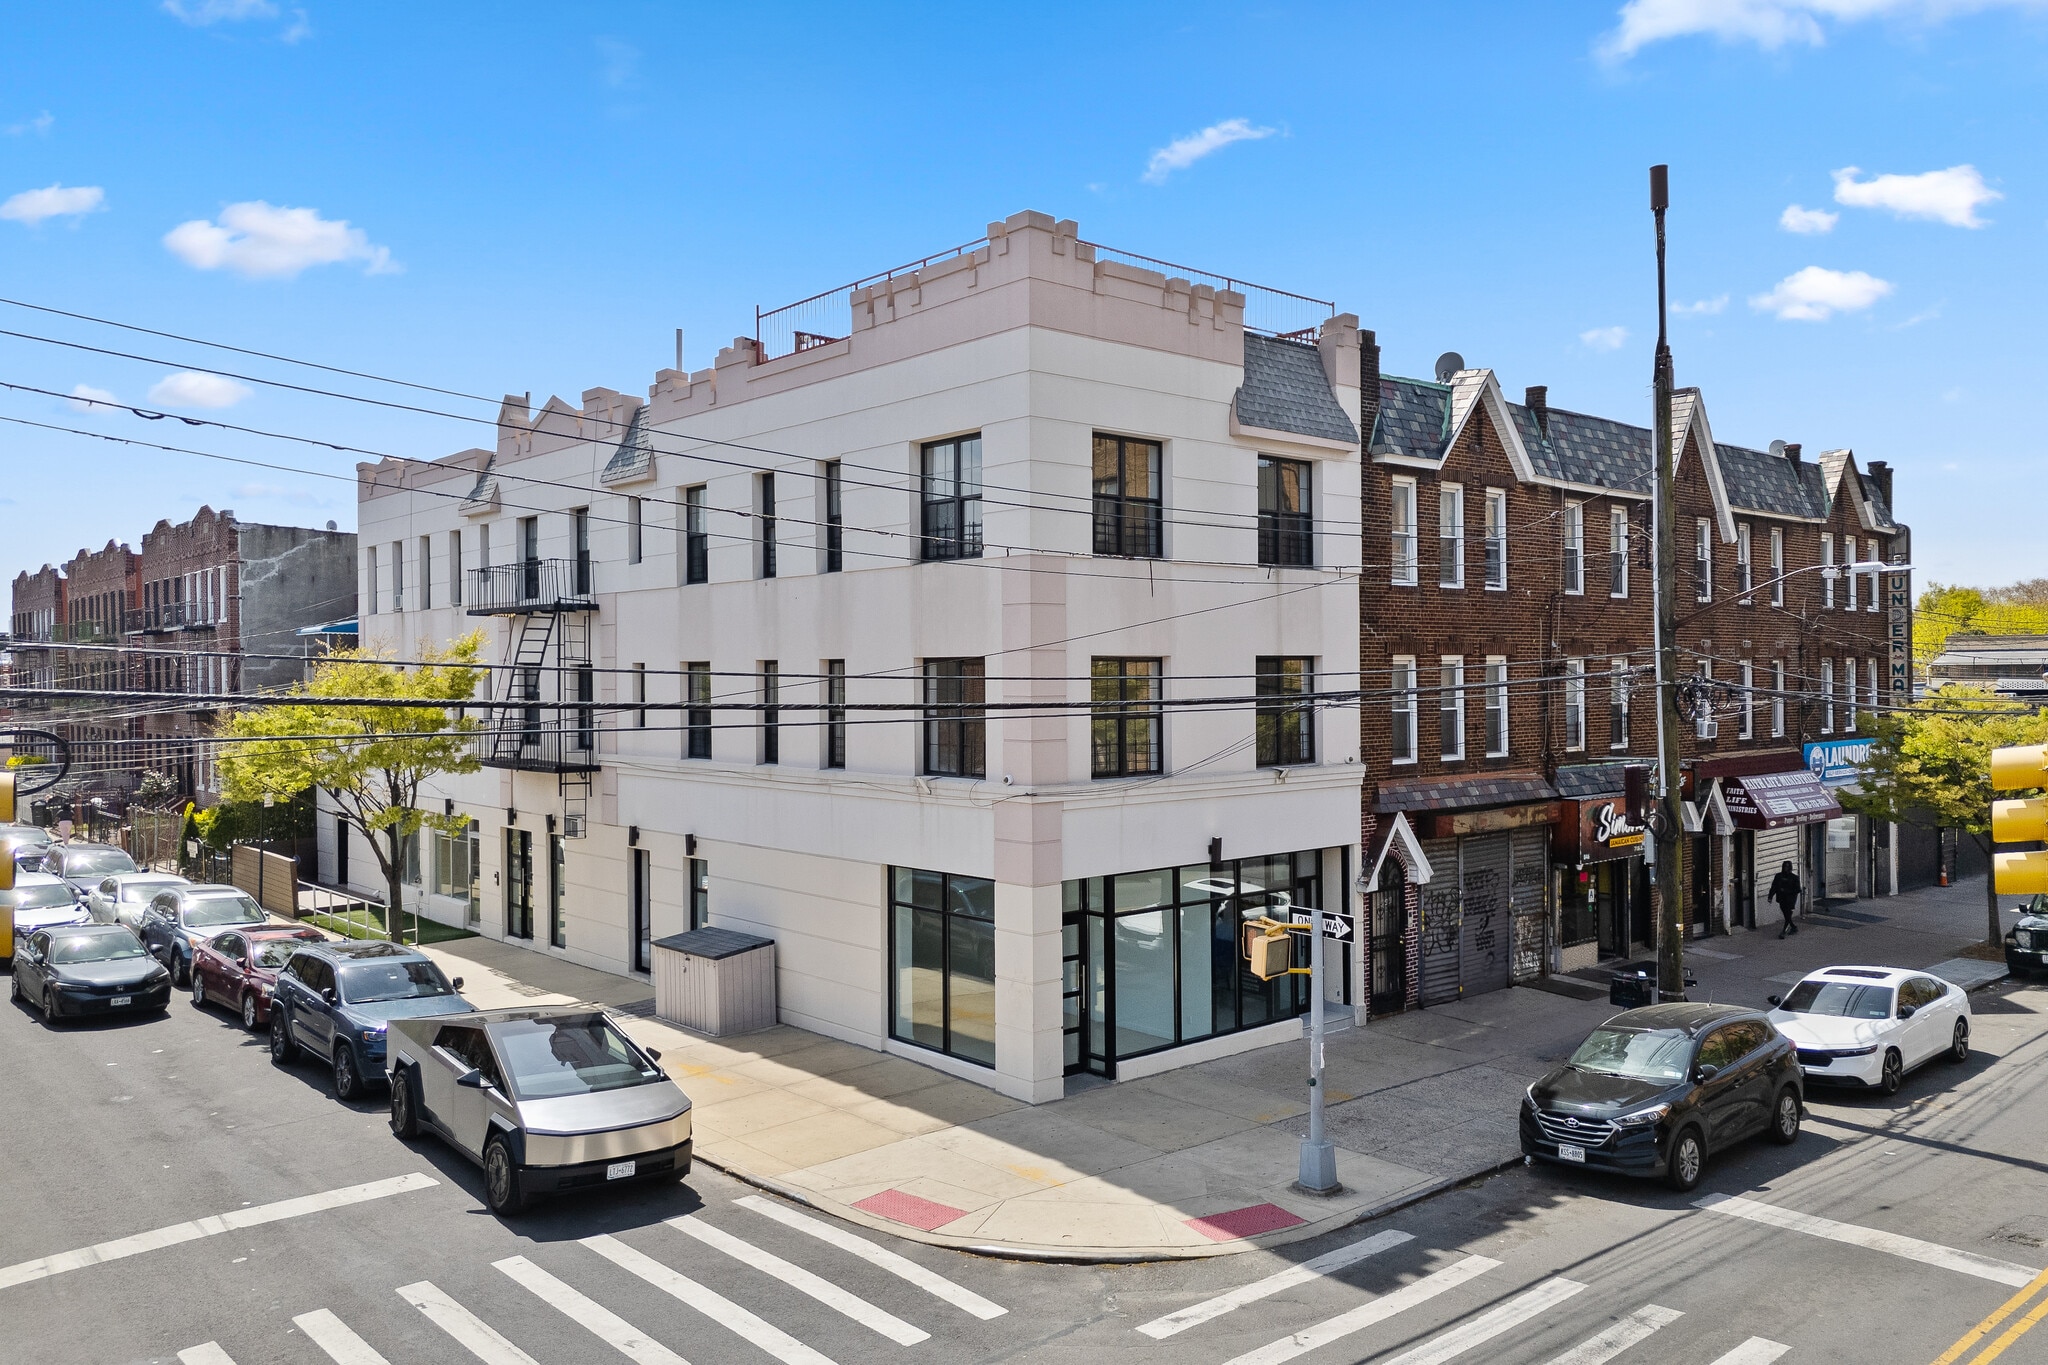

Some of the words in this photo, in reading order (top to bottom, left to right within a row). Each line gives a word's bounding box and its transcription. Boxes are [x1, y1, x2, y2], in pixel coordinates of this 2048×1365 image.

[1741, 778, 1767, 790] FAITH
[1762, 776, 1782, 788] LIFE
[1778, 772, 1820, 786] MINISTRIES
[1726, 787, 1745, 795] FAITH
[1726, 796, 1748, 804] LIFE
[1727, 805, 1758, 815] MINISTRIES
[1610, 838, 1630, 847] JAMAICAN
[1297, 915, 1312, 925] ON
[1325, 919, 1345, 933] WAY
